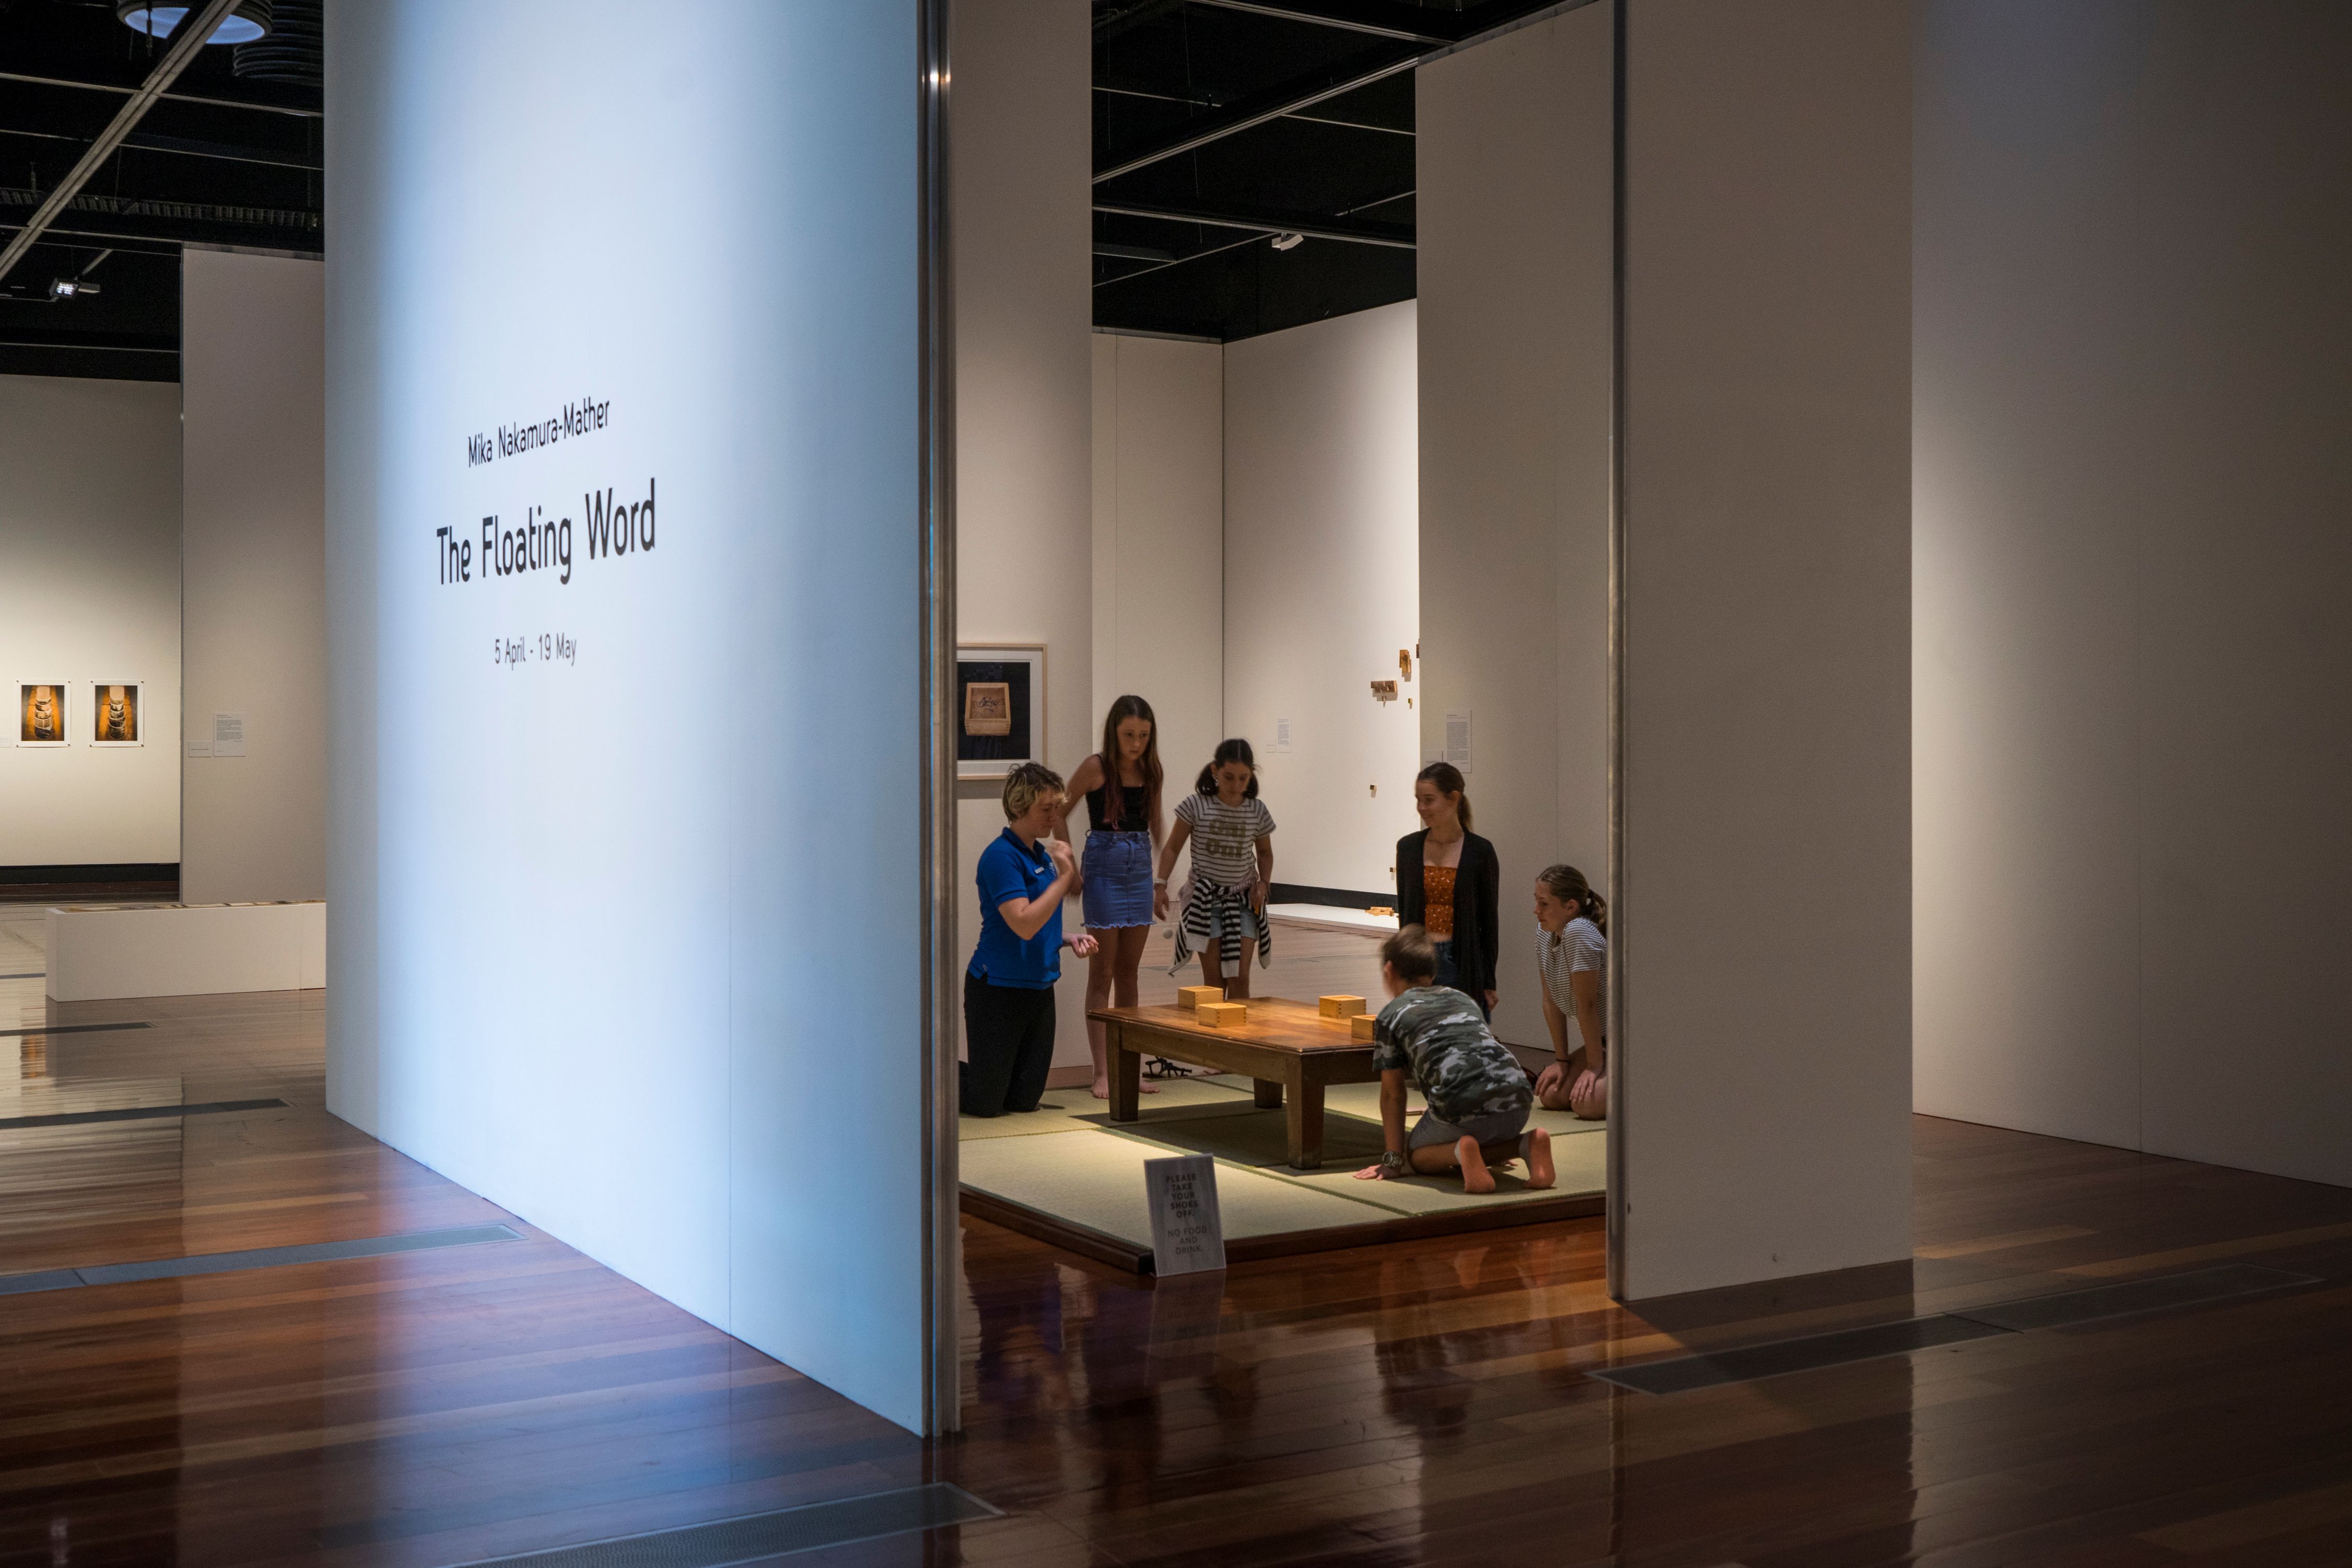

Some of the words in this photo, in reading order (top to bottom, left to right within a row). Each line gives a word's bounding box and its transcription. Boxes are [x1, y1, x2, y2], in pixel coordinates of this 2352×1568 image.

[467, 432, 493, 468] Mika
[498, 396, 610, 459] Nakamura-Mather
[436, 525, 471, 585] The
[482, 504, 572, 586] Floating
[584, 477, 656, 561] Word
[494, 638, 501, 665] 5
[504, 636, 527, 671] April
[538, 632, 551, 662] 19
[556, 631, 577, 667] May
[1166, 1173, 1197, 1183] PLEASE
[1171, 1182, 1193, 1191] TAKE
[1171, 1191, 1195, 1201] YOUR
[1170, 1200, 1198, 1210] SHOES
[1167, 1229, 1180, 1237] NO
[1183, 1226, 1207, 1235] FOOD
[1180, 1236, 1197, 1245] AND
